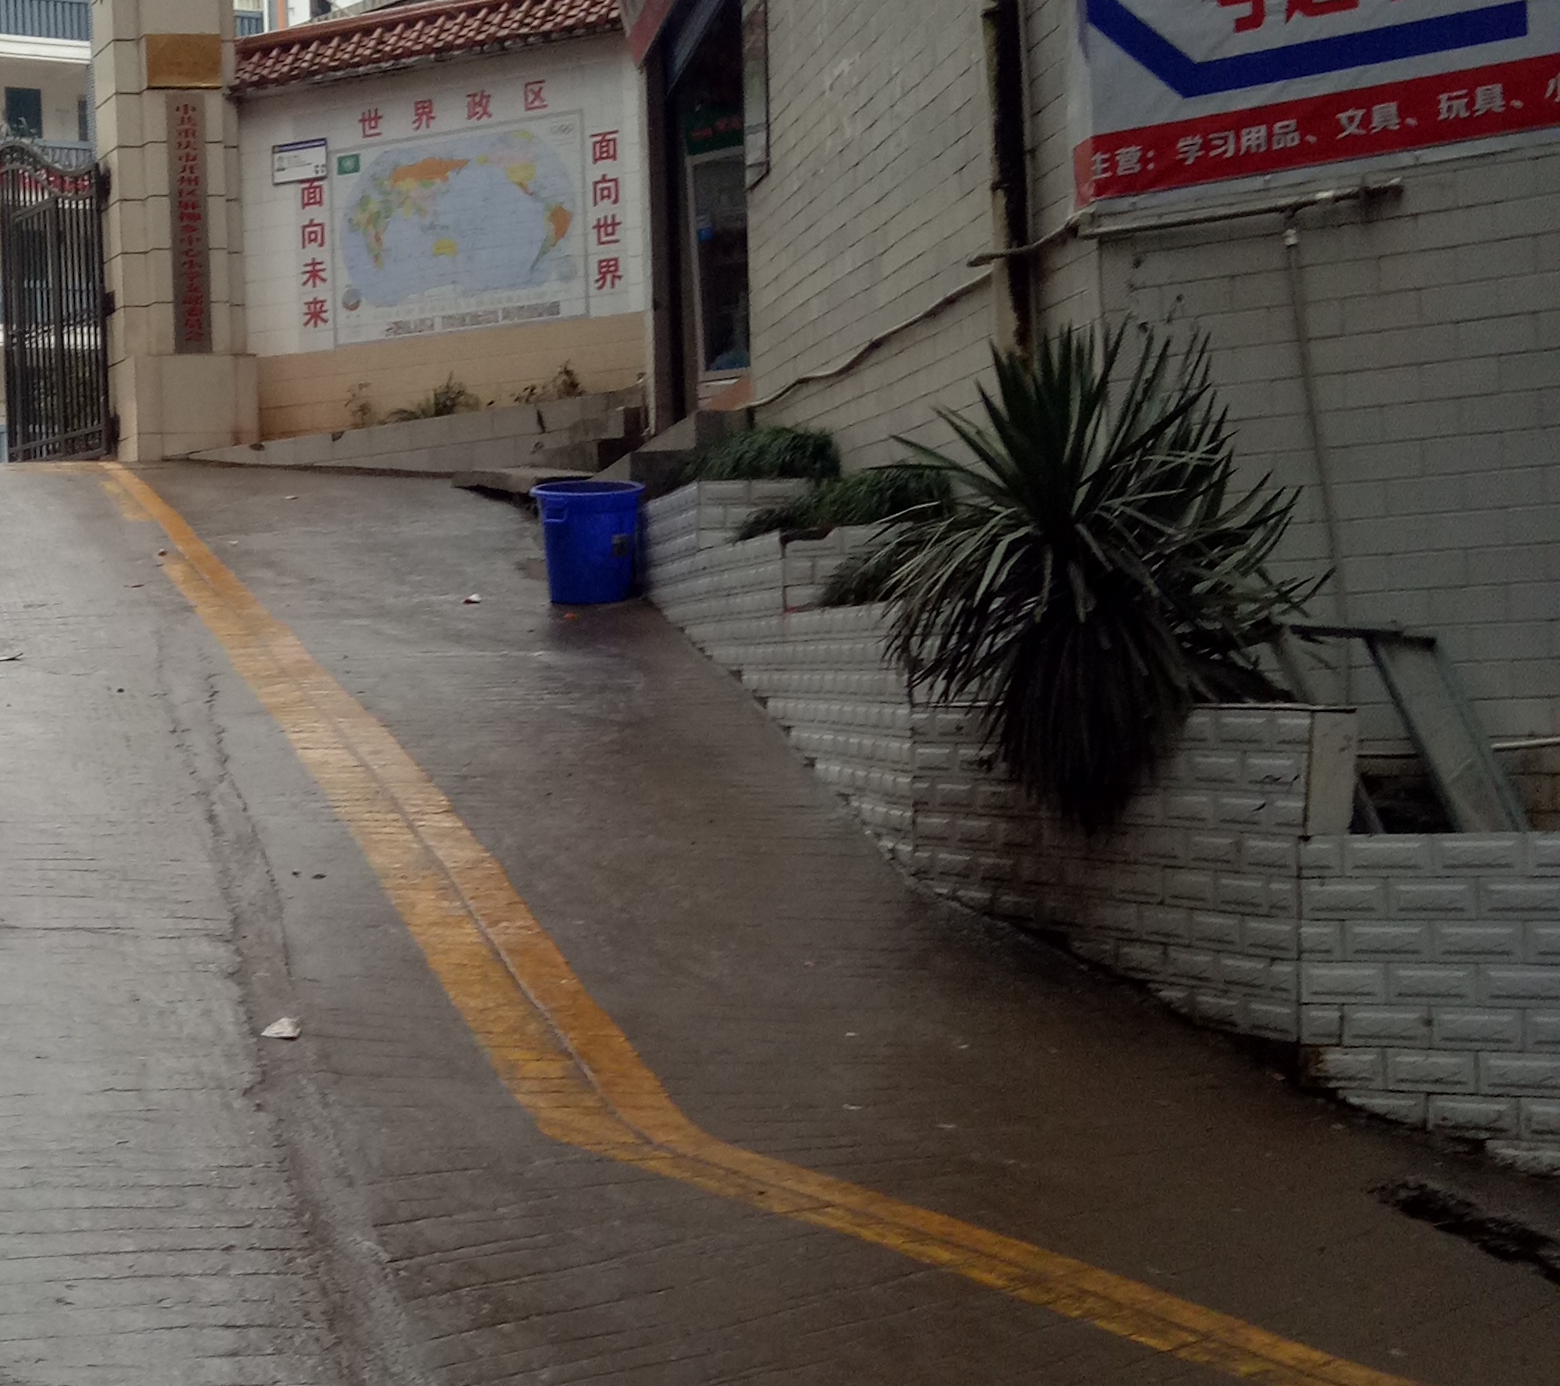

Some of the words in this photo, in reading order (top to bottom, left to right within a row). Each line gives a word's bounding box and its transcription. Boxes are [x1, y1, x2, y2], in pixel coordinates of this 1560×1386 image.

[358, 79, 549, 139] 世界政区
[300, 179, 330, 330] 面向未来
[590, 129, 624, 291] 面向世界
